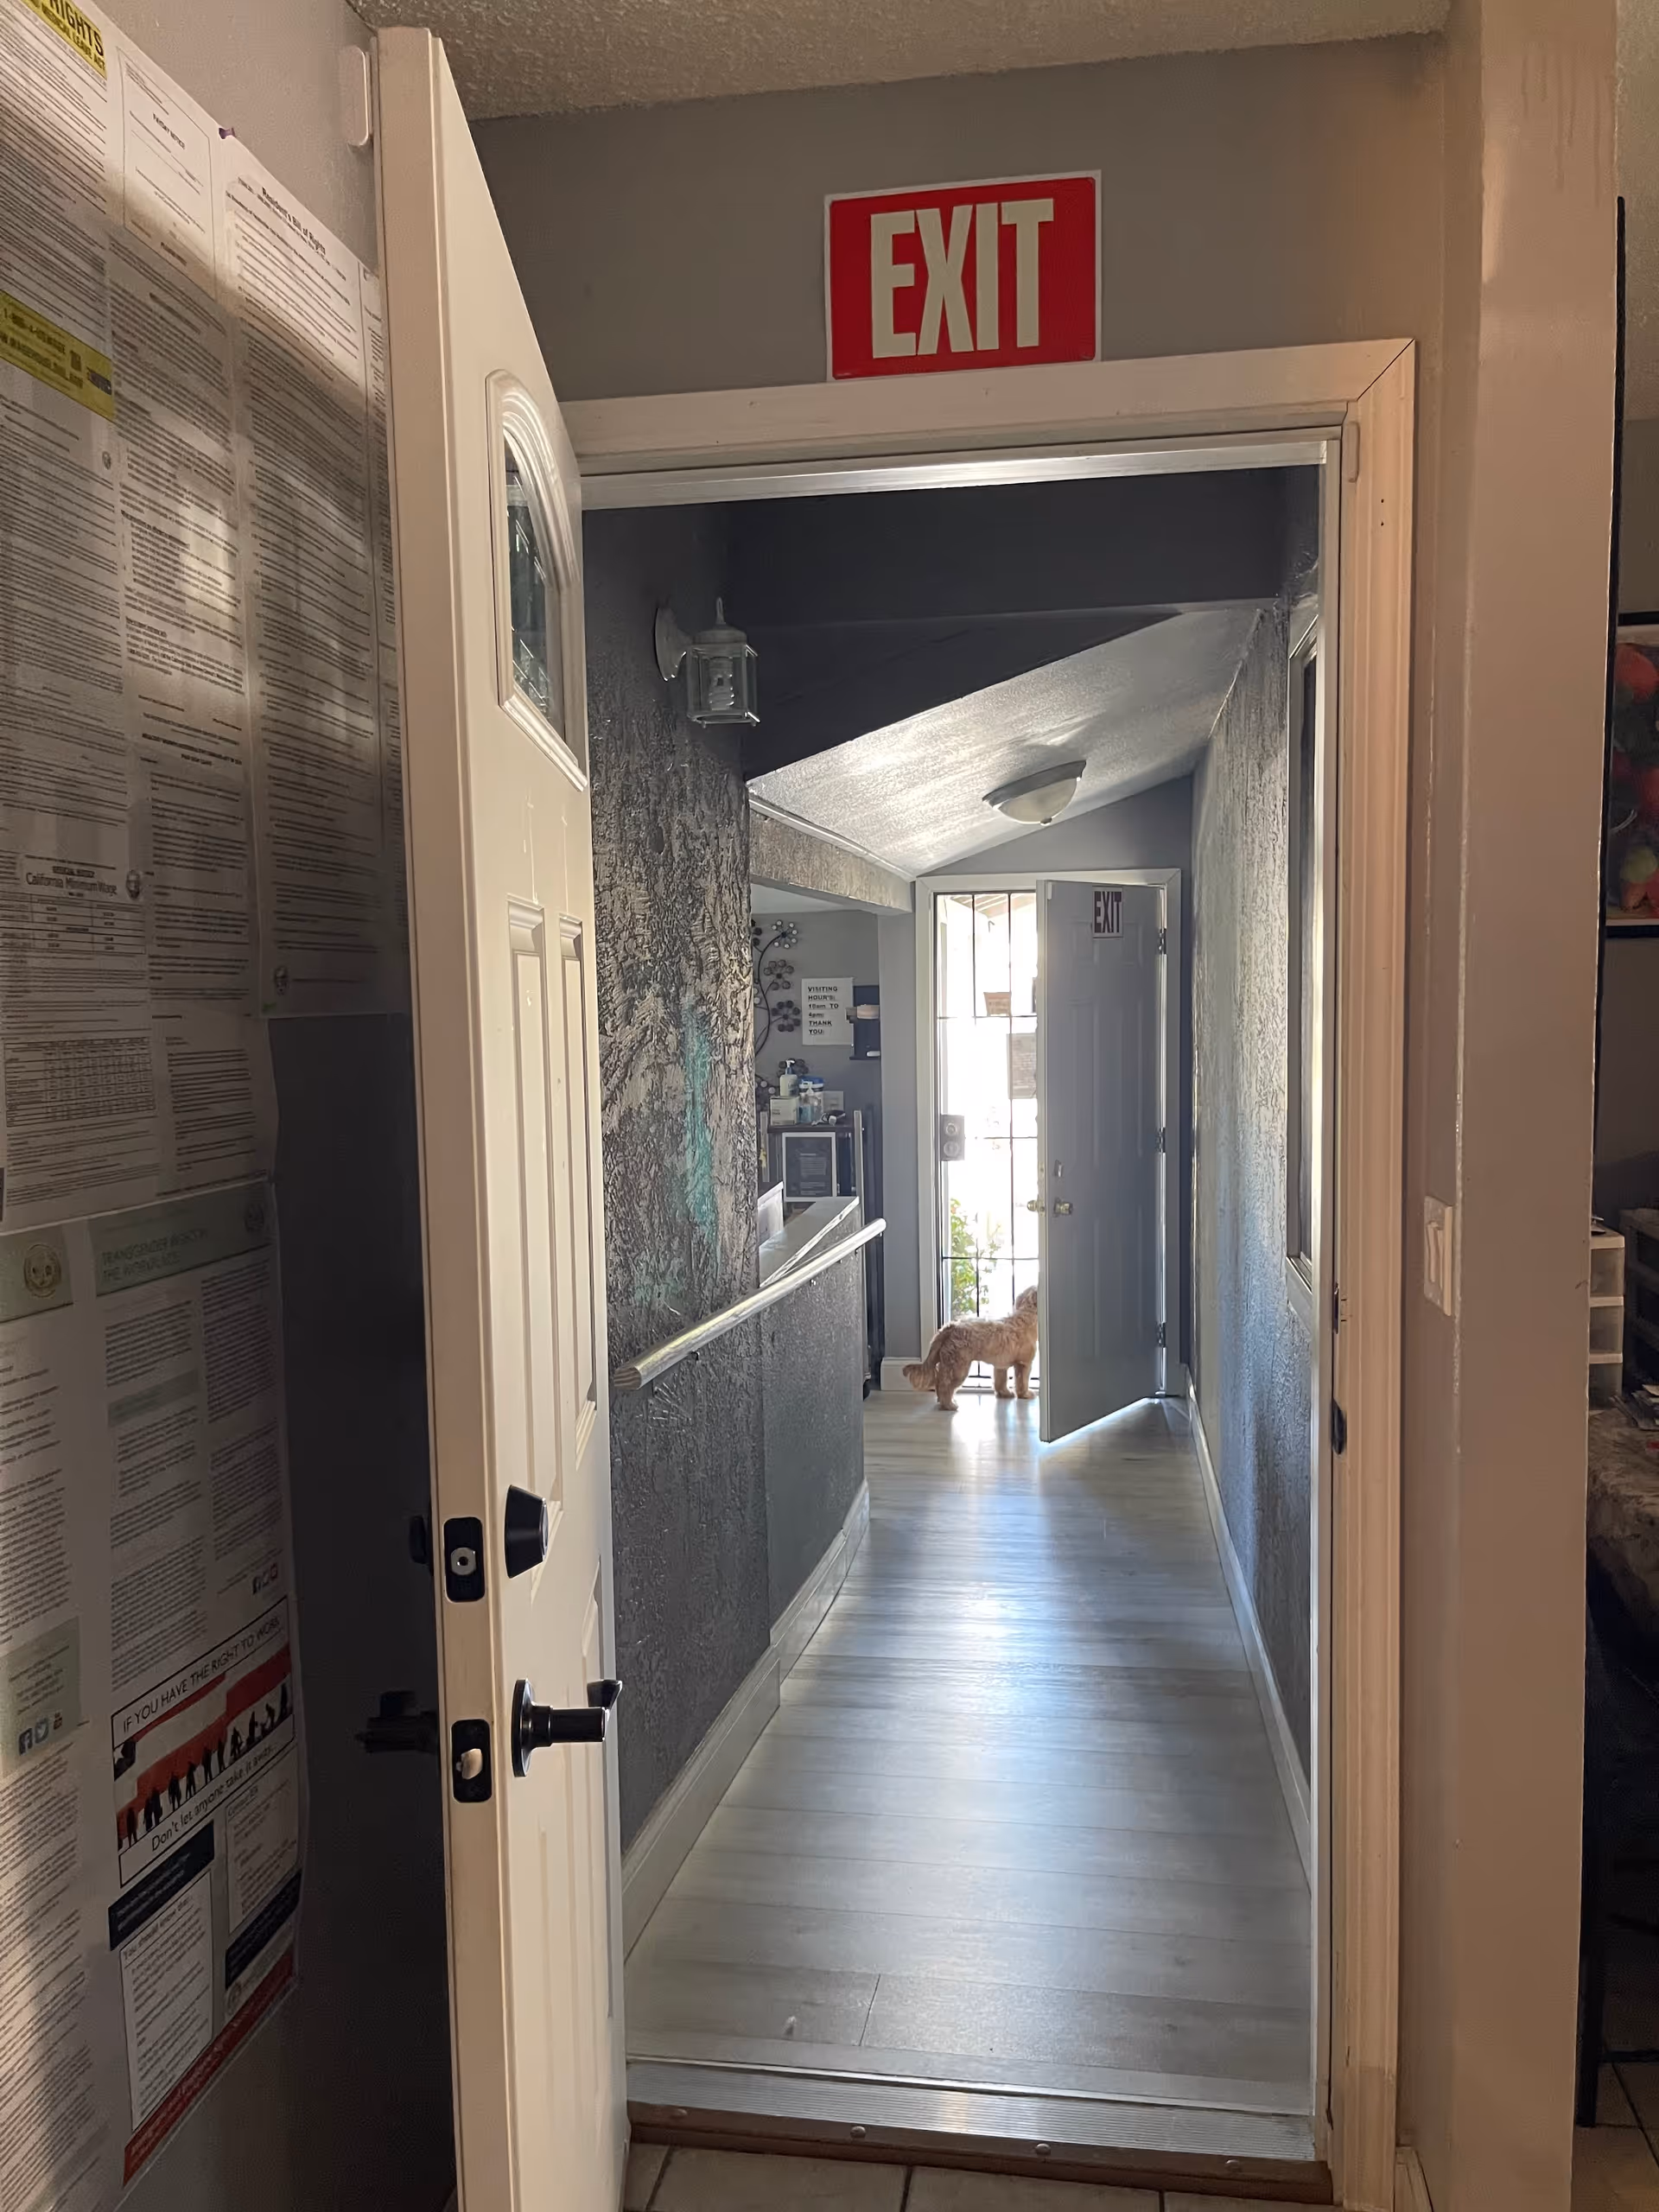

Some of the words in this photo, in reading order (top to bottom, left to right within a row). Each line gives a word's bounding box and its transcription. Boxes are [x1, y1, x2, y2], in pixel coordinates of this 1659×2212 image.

[870, 198, 1053, 359] EXIT
[26, 872, 64, 888] California
[97, 880, 118, 897] Wage
[1094, 891, 1122, 933] EXIT
[123, 1715, 132, 1733] IF
[134, 1700, 159, 1726] YOU
[161, 1678, 188, 1709] HAVE
[189, 1664, 211, 1688] THE
[211, 1644, 240, 1673] RIGHT
[240, 1635, 256, 1651] TO
[257, 1615, 281, 1642] WORK
[151, 1821, 179, 1852] Don't
[180, 1811, 193, 1827] let
[194, 1784, 224, 1819] anyone
[225, 1768, 245, 1789] take
